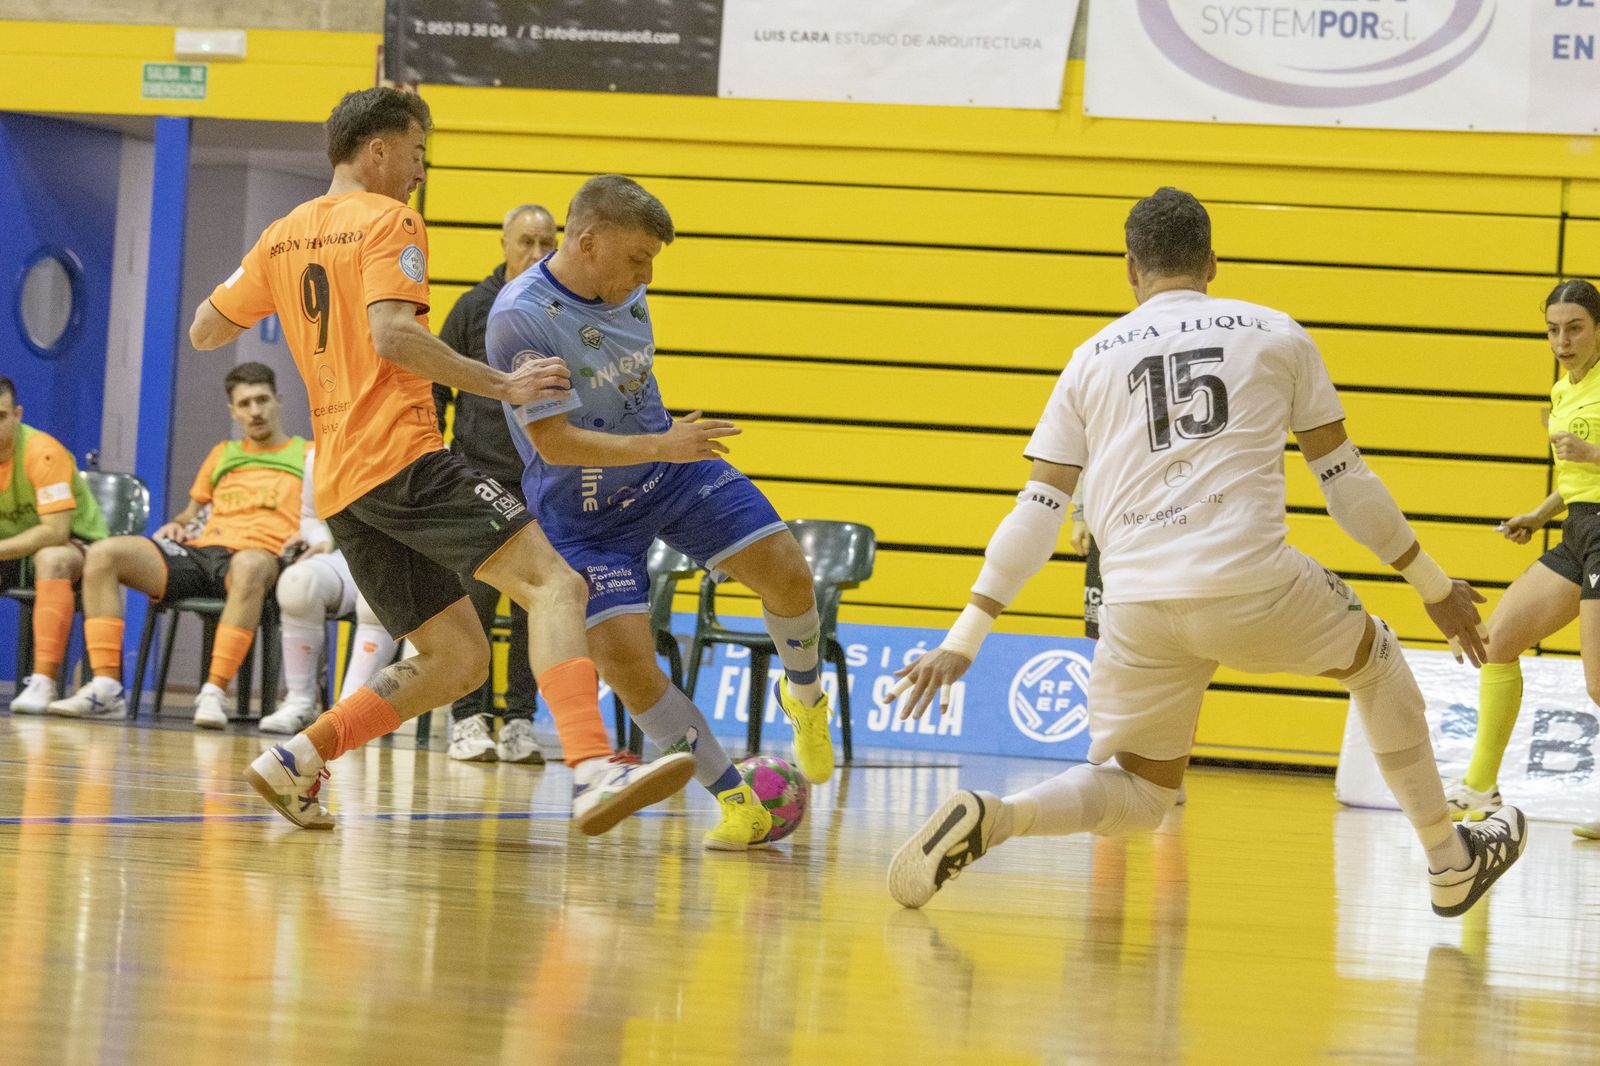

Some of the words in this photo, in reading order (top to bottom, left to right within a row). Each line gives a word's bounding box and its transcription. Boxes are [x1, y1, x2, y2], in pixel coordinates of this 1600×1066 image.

[753, 29, 786, 43] LUIS
[790, 30, 830, 44] CARA
[834, 32, 898, 47] ESTUDIO
[902, 33, 922, 47] DE
[926, 34, 1042, 50] ARQUITECTURA
[1553, 34, 1594, 60] EN
[300, 263, 330, 355] 9
[1095, 325, 1160, 355] RAFA
[1180, 315, 1271, 333] LUQUE
[1128, 347, 1229, 453] 15
[587, 565, 609, 573] Grupo
[595, 581, 606, 592] &
